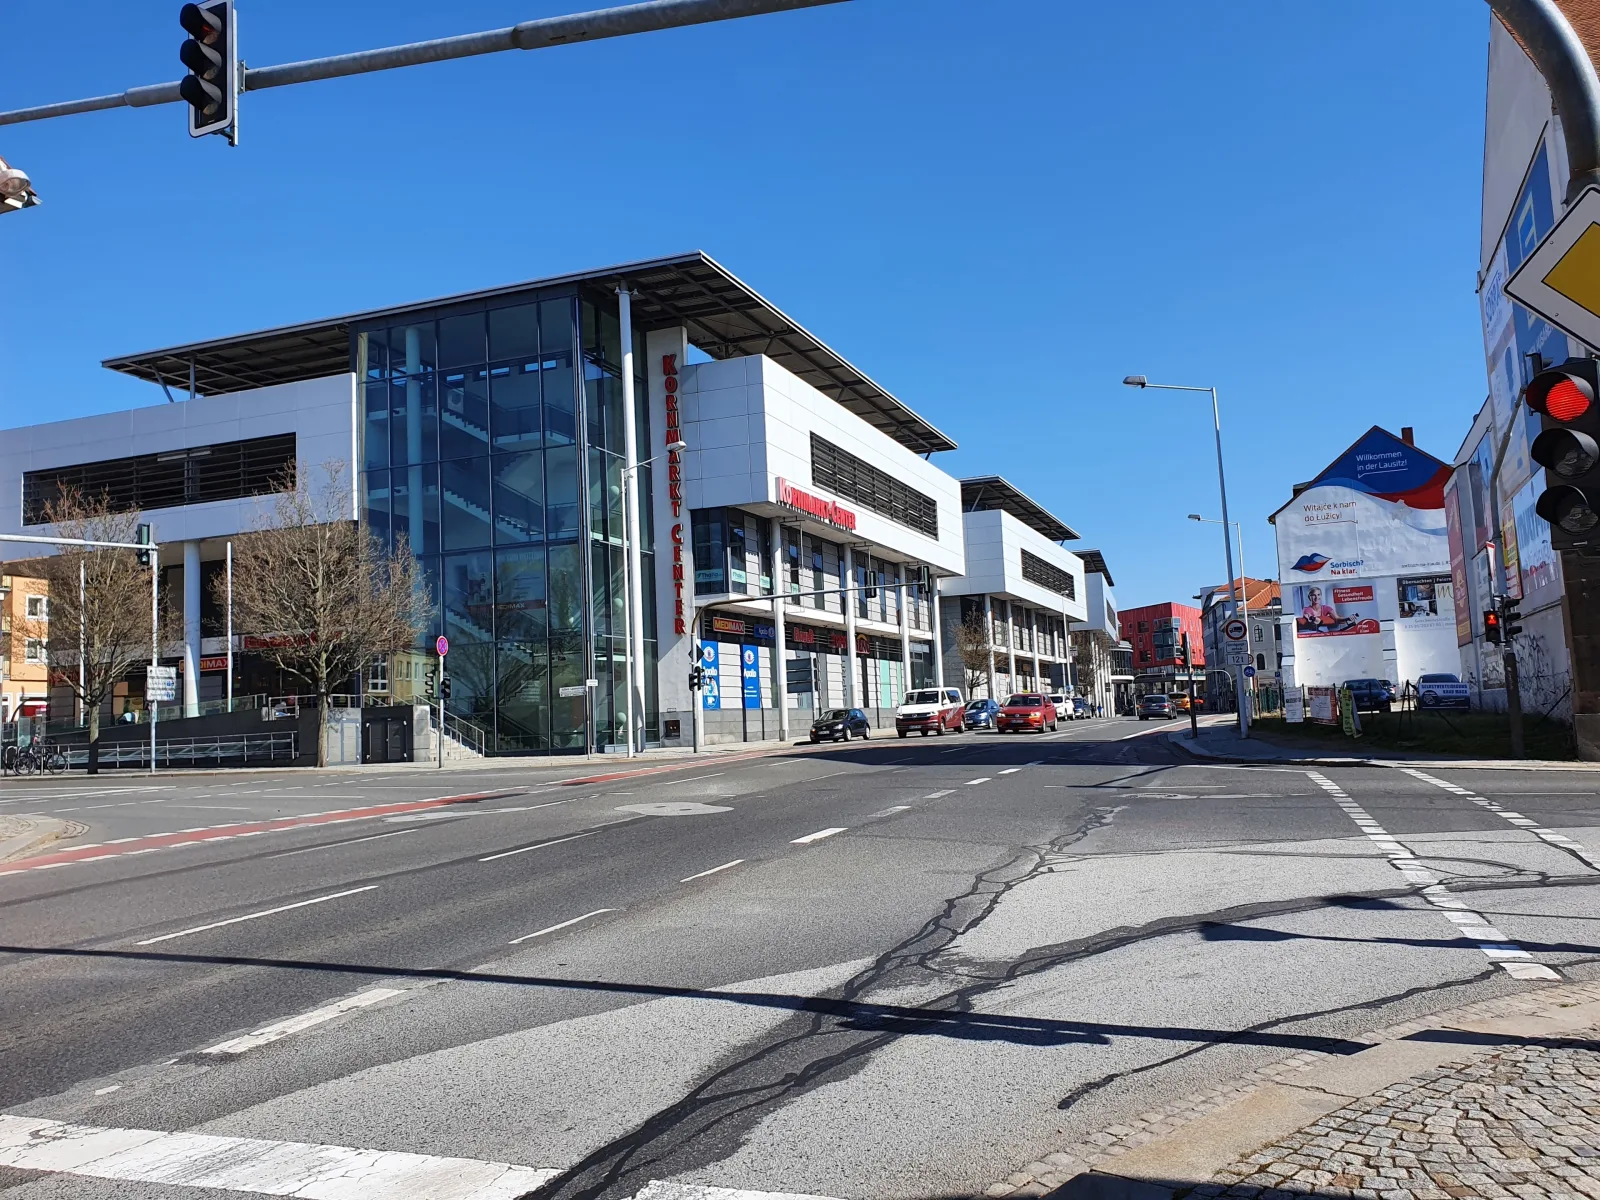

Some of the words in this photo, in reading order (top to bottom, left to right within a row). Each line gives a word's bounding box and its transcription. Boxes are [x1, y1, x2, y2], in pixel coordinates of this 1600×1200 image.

[1355, 451, 1402, 461] Willkommen
[1357, 463, 1364, 471] in
[1365, 462, 1378, 470] der
[1378, 459, 1408, 469] Lausitz!
[1339, 501, 1357, 509] nam
[1304, 514, 1315, 522] do
[1330, 559, 1364, 569] Sorbisch?
[671, 523, 686, 635] CENTER
[714, 619, 744, 632] MEDIMAX
